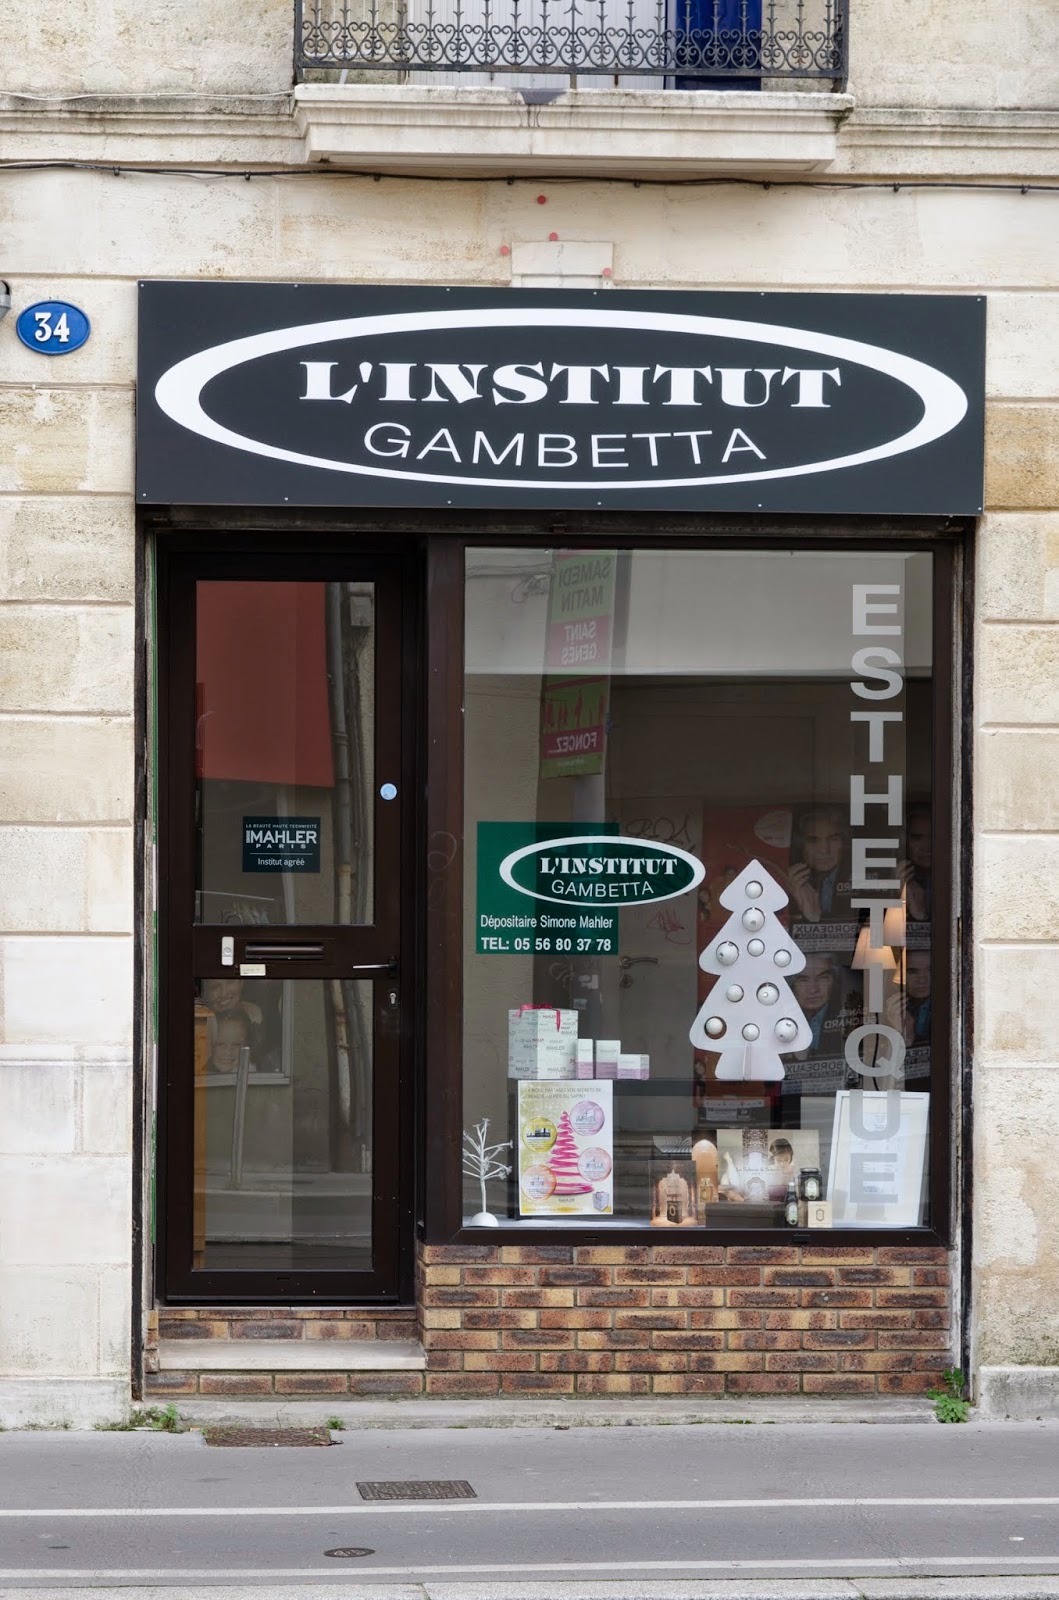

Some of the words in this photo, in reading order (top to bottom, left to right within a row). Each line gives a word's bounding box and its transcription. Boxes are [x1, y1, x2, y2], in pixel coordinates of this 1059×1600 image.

[34, 312, 70, 343] 34
[299, 361, 842, 408] L'INSTITUT
[363, 422, 767, 468] GAMBETTA
[250, 830, 317, 844] MAHLER
[257, 857, 283, 866] Institut
[283, 858, 305, 867] agréé
[539, 857, 678, 875] L'INSTITUT
[551, 879, 654, 898] GAMBETTA
[843, 583, 907, 1205] ESTHETIQUE
[480, 914, 537, 930] Dépositaire
[540, 915, 577, 929] Simone
[579, 915, 613, 929] Mahler
[481, 937, 510, 950] TEL:
[514, 937, 530, 951] 05
[535, 937, 551, 951] 56
[555, 938, 572, 951] 80
[576, 938, 592, 951] 37
[596, 938, 612, 951] 78
